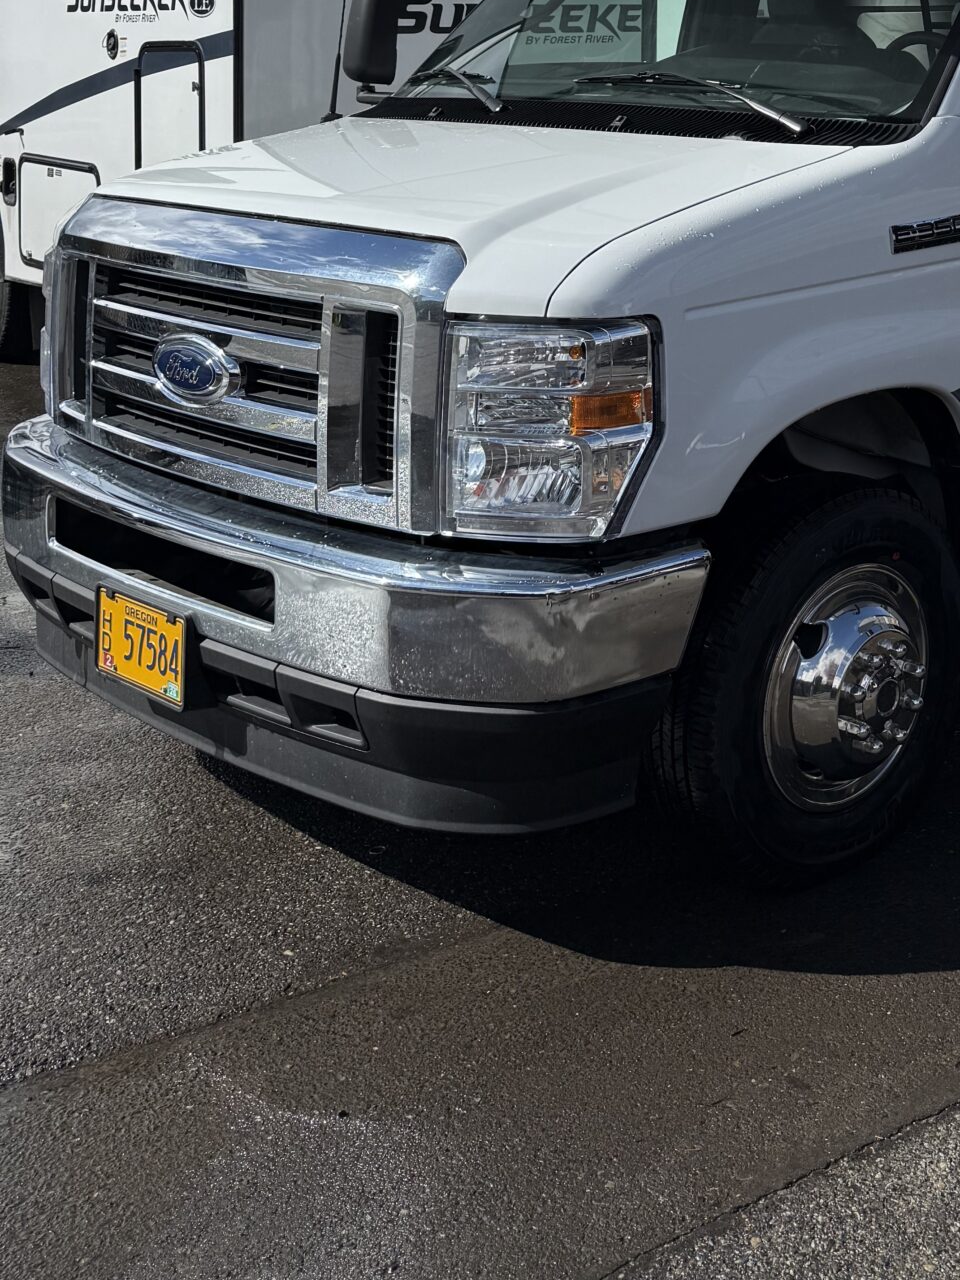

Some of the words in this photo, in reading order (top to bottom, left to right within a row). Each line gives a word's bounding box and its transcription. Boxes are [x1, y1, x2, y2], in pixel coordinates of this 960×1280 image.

[525, 35, 541, 45] BY
[543, 34, 583, 45] FOREST
[585, 33, 615, 44] RIVER
[165, 352, 200, 384] Ford
[124, 605, 158, 626] OREGON
[124, 618, 179, 682] 57584
